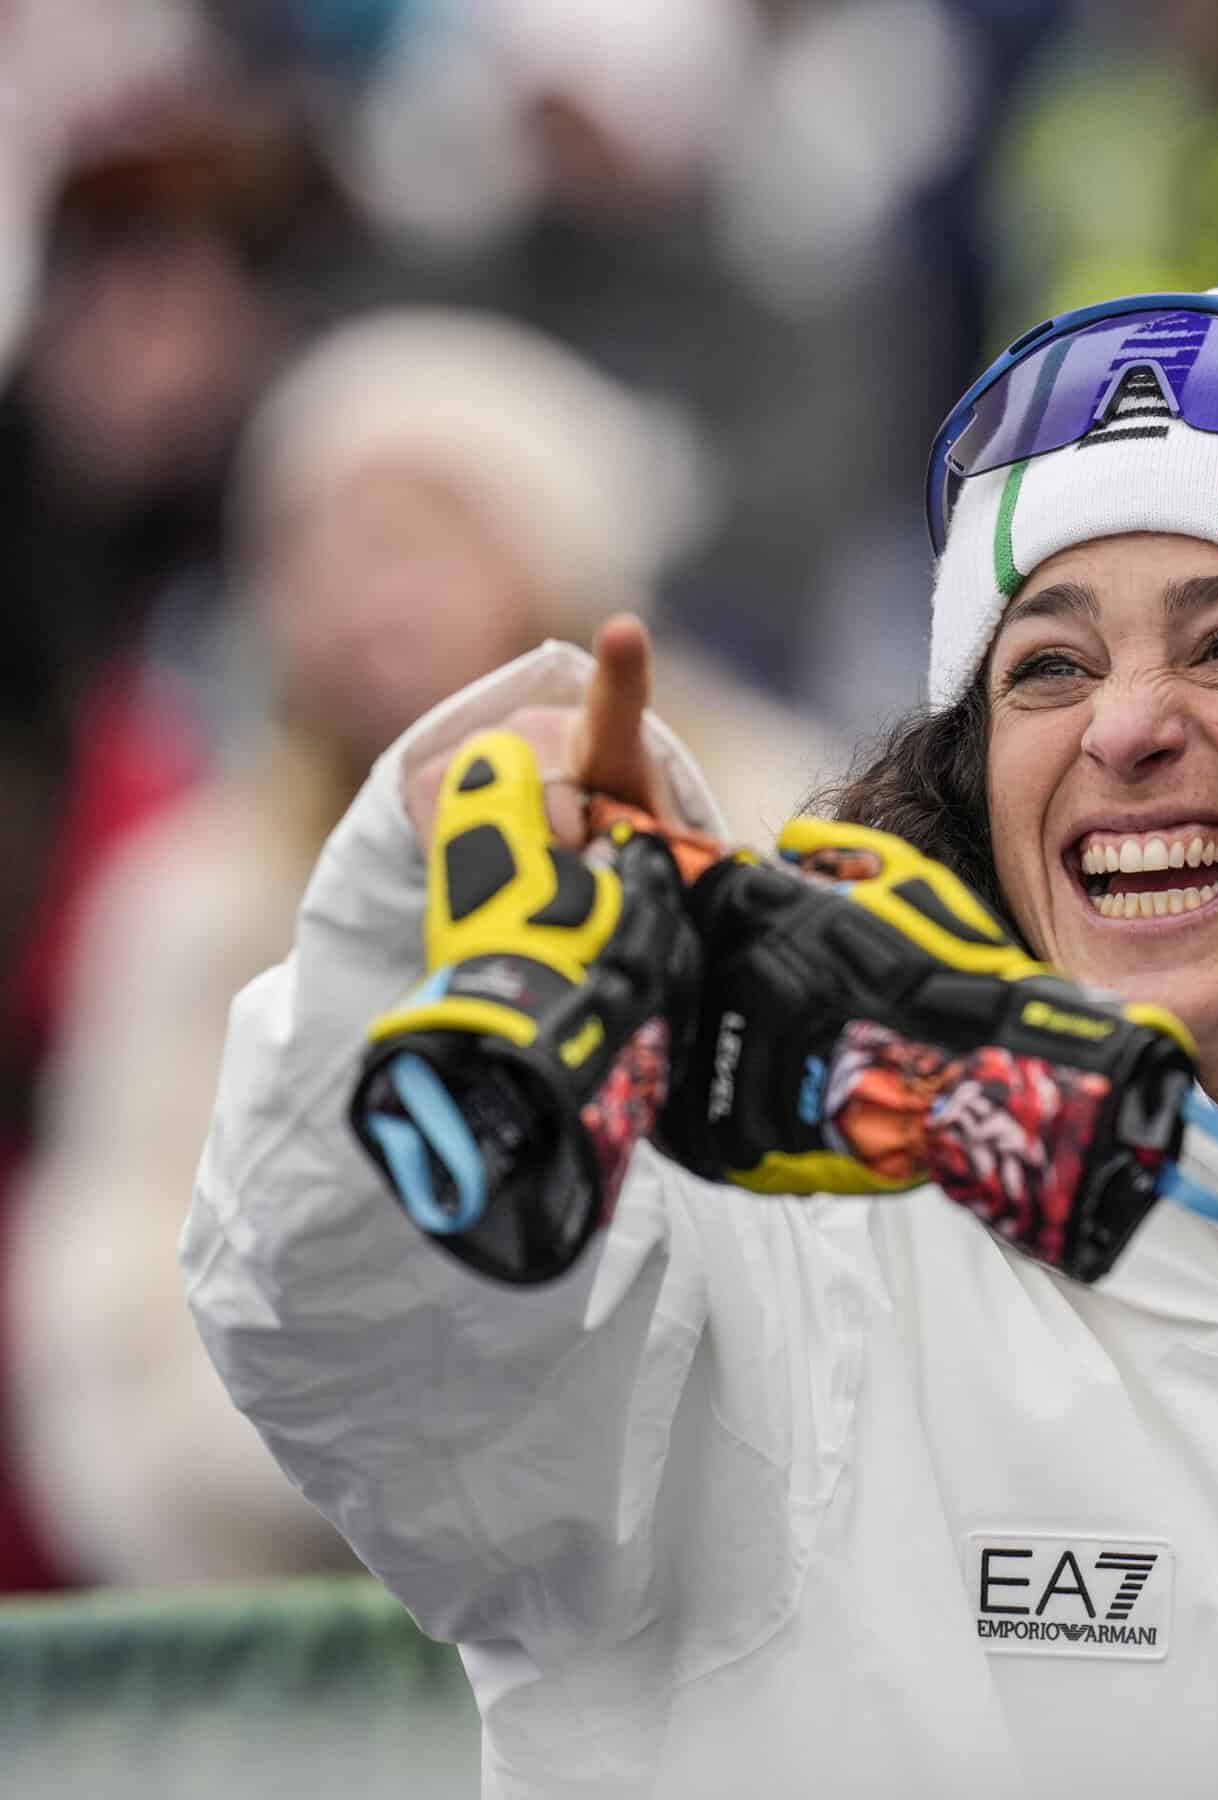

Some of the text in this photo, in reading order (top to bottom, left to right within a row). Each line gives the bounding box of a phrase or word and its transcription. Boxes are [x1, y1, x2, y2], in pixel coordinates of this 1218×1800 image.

[980, 1547, 1158, 1620] EA7
[977, 1619, 1157, 1646] EMPORIO ARMANI
